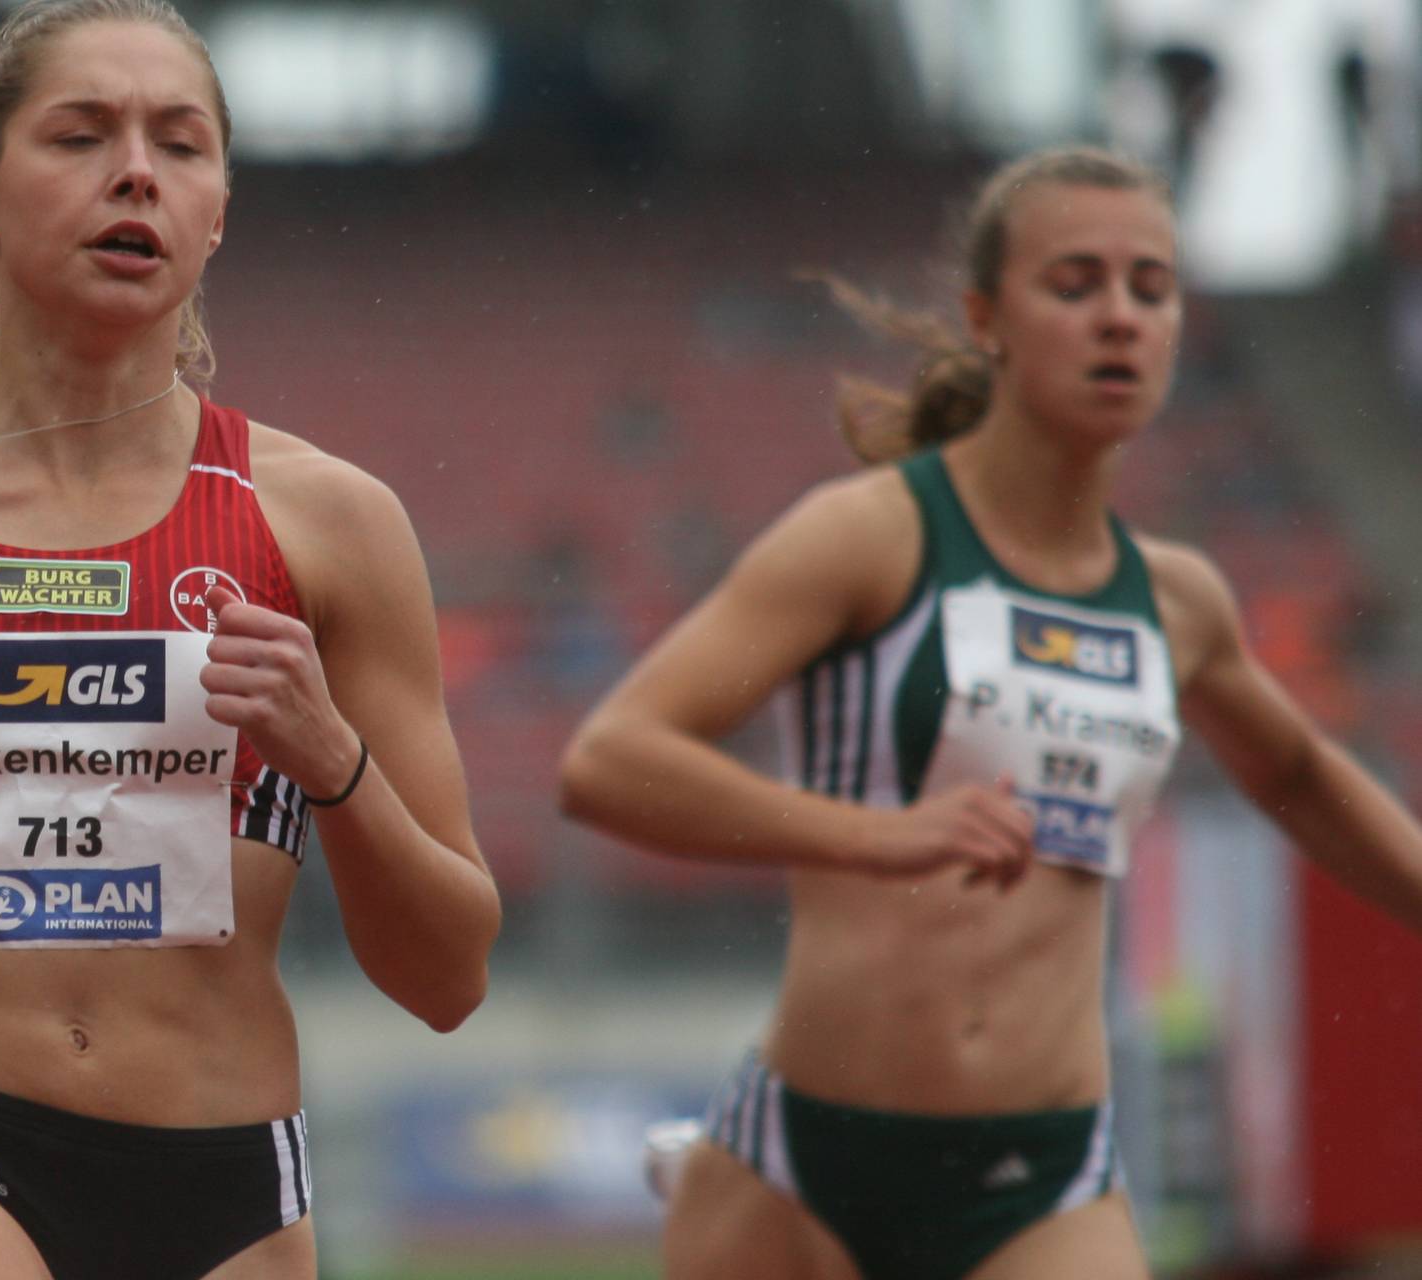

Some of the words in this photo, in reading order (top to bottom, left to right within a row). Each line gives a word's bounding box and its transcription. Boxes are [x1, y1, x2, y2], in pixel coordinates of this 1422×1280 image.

[25, 569, 91, 585] BURG
[0, 584, 112, 605] WÄCHTER
[67, 665, 147, 705] GLS
[18, 816, 103, 858] 713
[45, 882, 152, 913] PLAN
[45, 918, 153, 930] INTERNATIONAL
